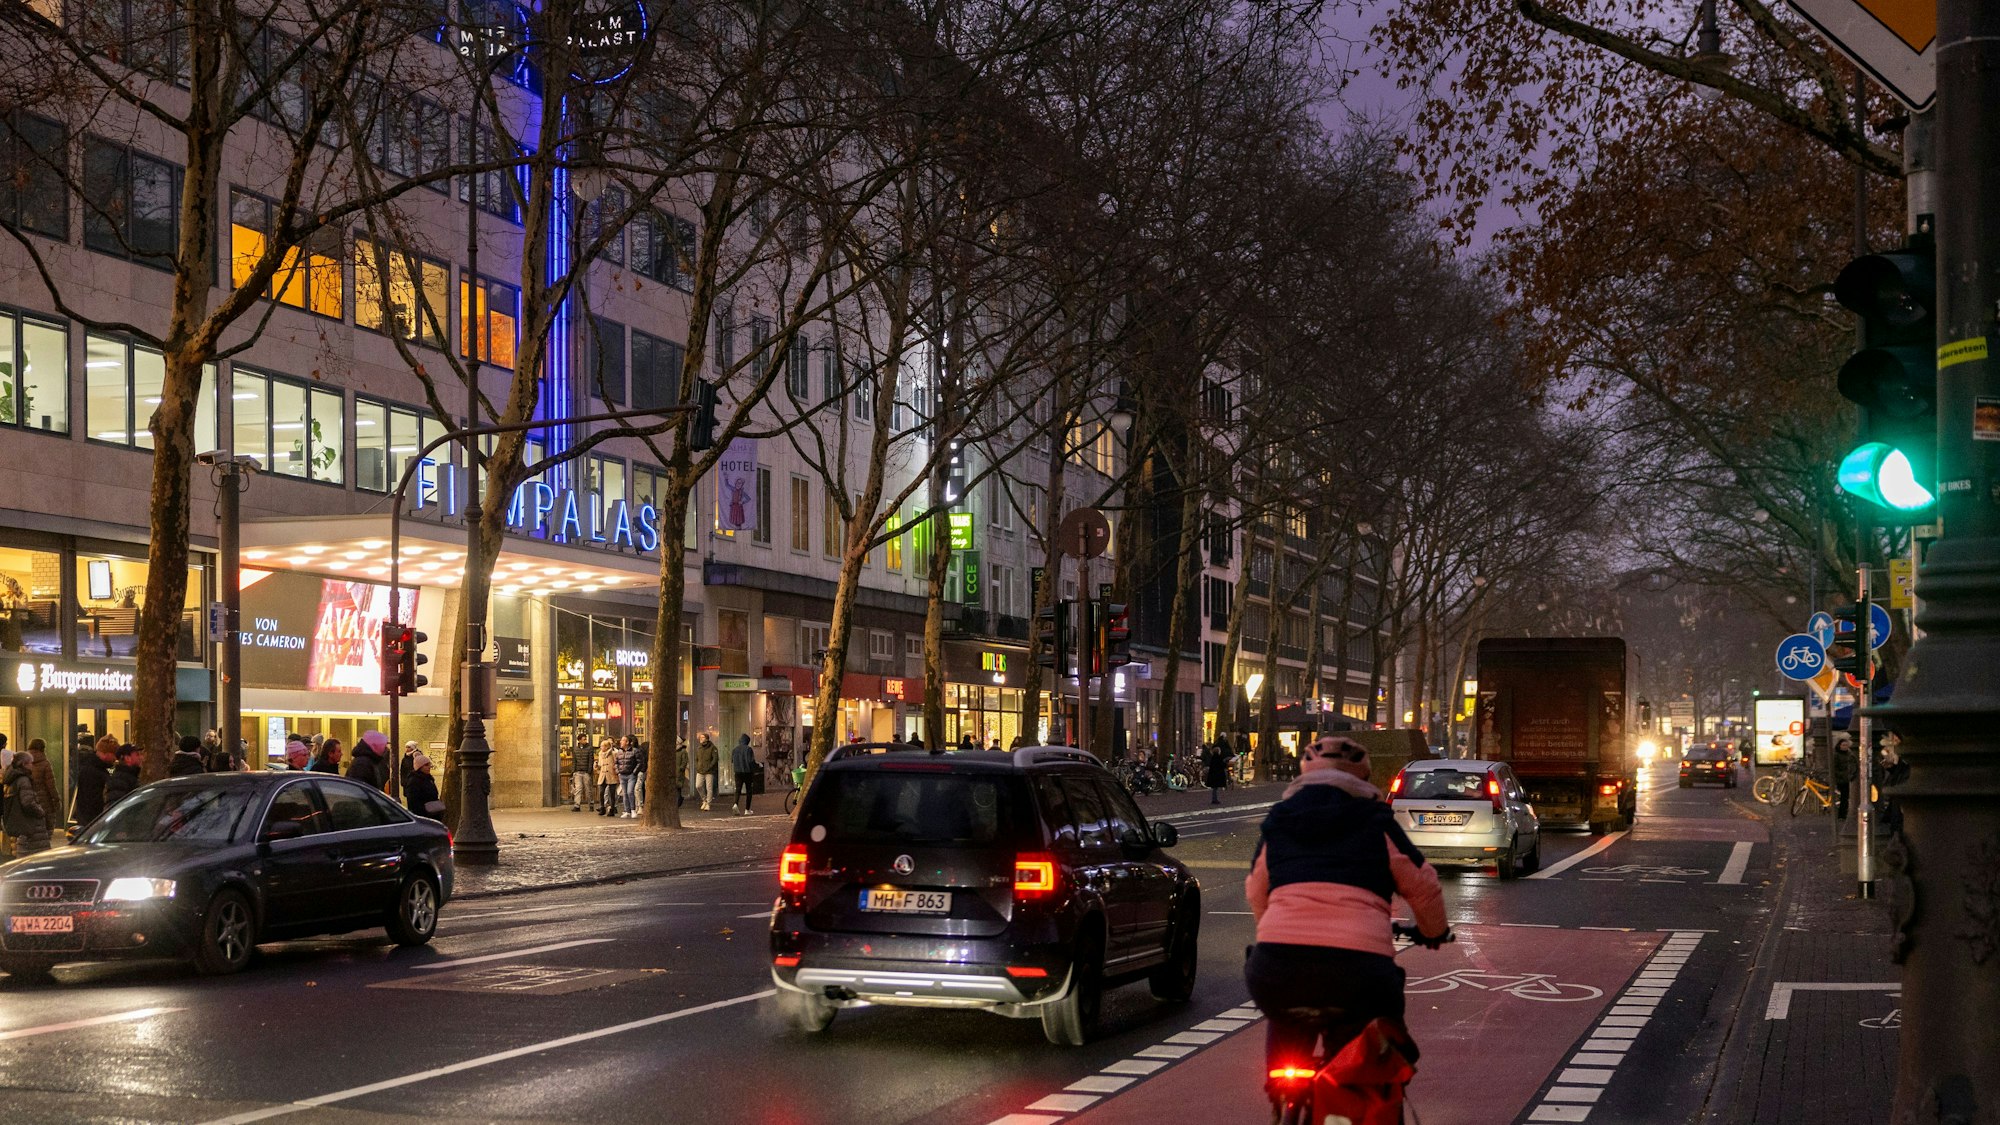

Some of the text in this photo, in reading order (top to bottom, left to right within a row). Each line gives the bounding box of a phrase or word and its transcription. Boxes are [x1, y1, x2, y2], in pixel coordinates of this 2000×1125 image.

[721, 461, 755, 472] HOTEL
[417, 457, 658, 551] FIMPALAS
[966, 564, 977, 594] CCE
[255, 617, 278, 632] VON
[315, 601, 382, 641] AVATA
[256, 633, 306, 650] CAMERON
[616, 650, 648, 667] BRICCO
[982, 651, 1007, 673] BUTLERS
[40, 663, 133, 694] Burgermeister
[886, 679, 904, 694] REWE
[1449, 815, 1462, 823] 912
[873, 891, 945, 909] MH F 863
[12, 918, 20, 931] K
[43, 917, 71, 931] 2204
